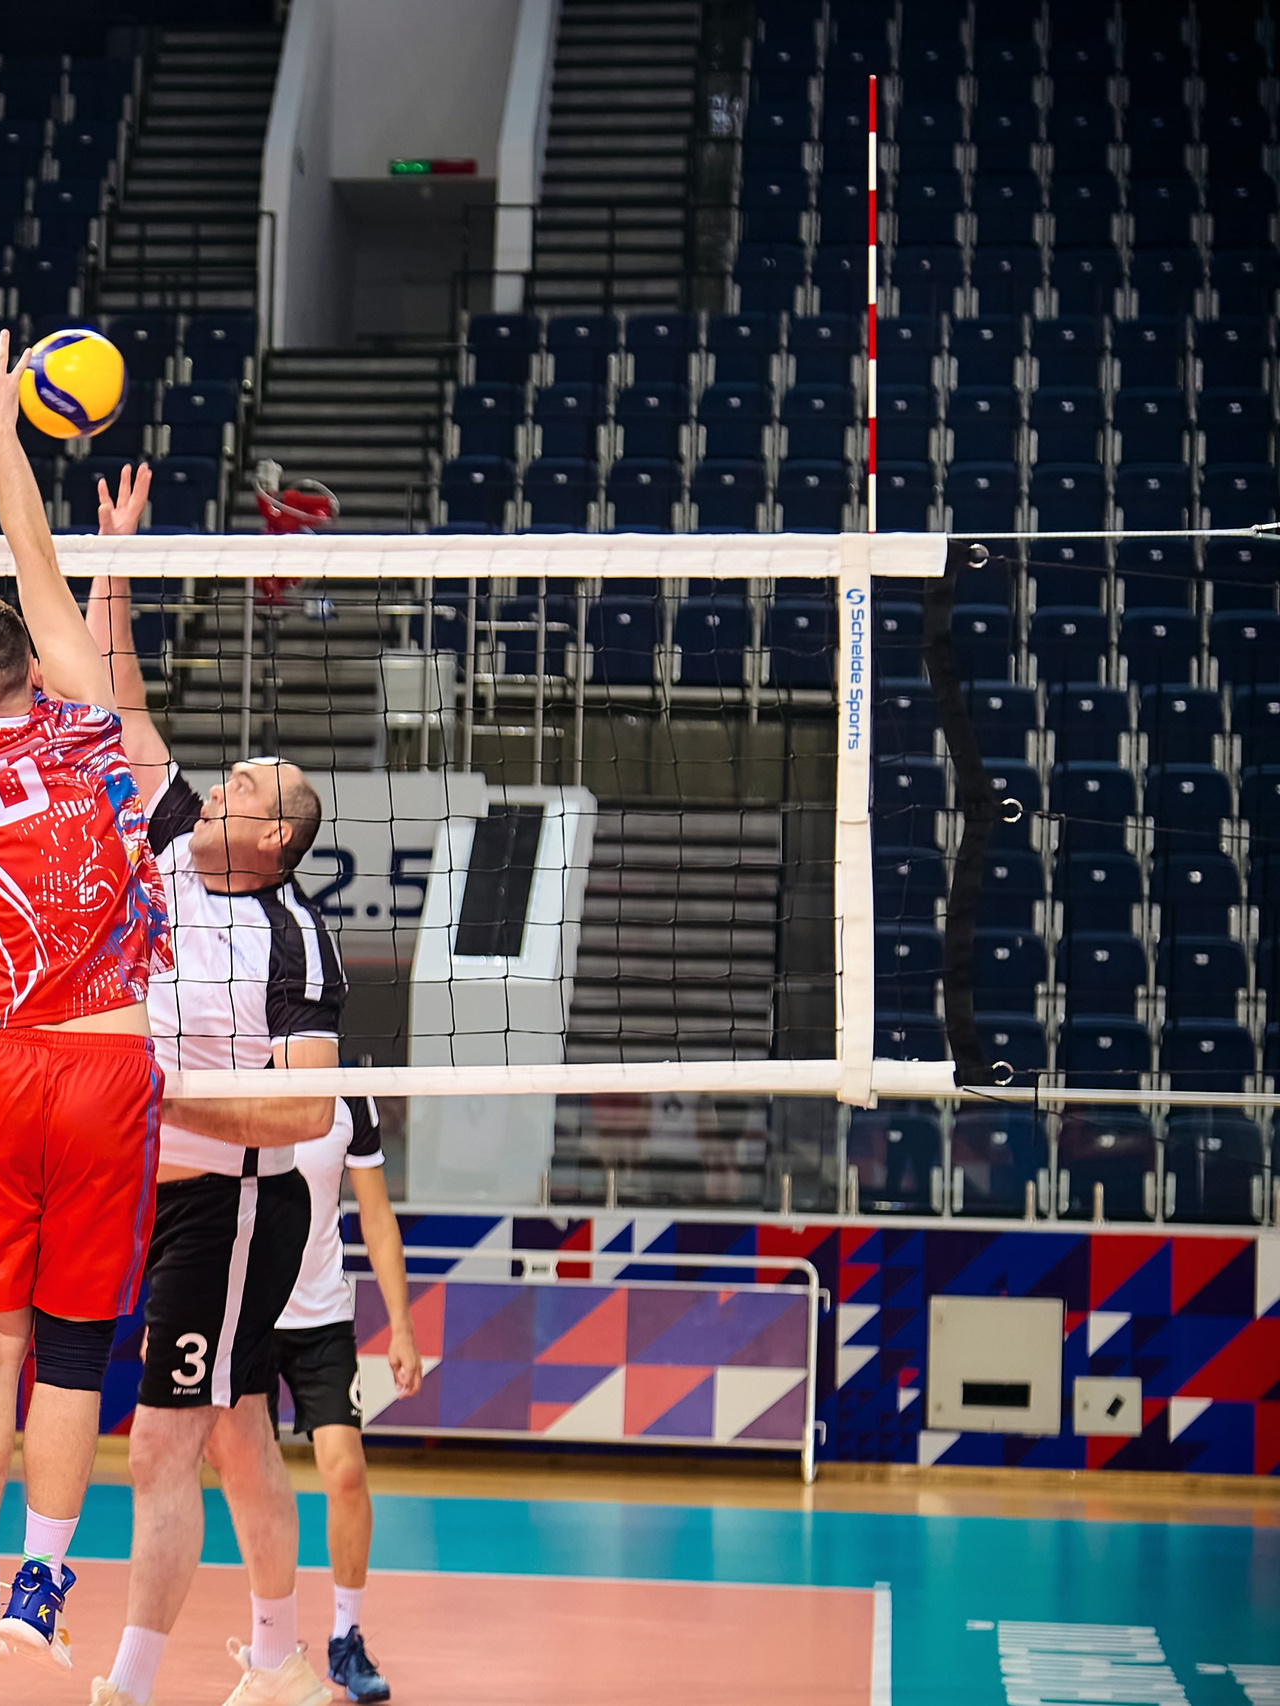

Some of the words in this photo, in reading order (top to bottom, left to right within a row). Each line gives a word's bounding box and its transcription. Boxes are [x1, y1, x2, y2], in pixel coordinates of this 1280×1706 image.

[850, 608, 865, 684] Schelde
[845, 688, 863, 750] Sports
[309, 848, 433, 918] 2.5
[171, 1332, 208, 1387] 3
